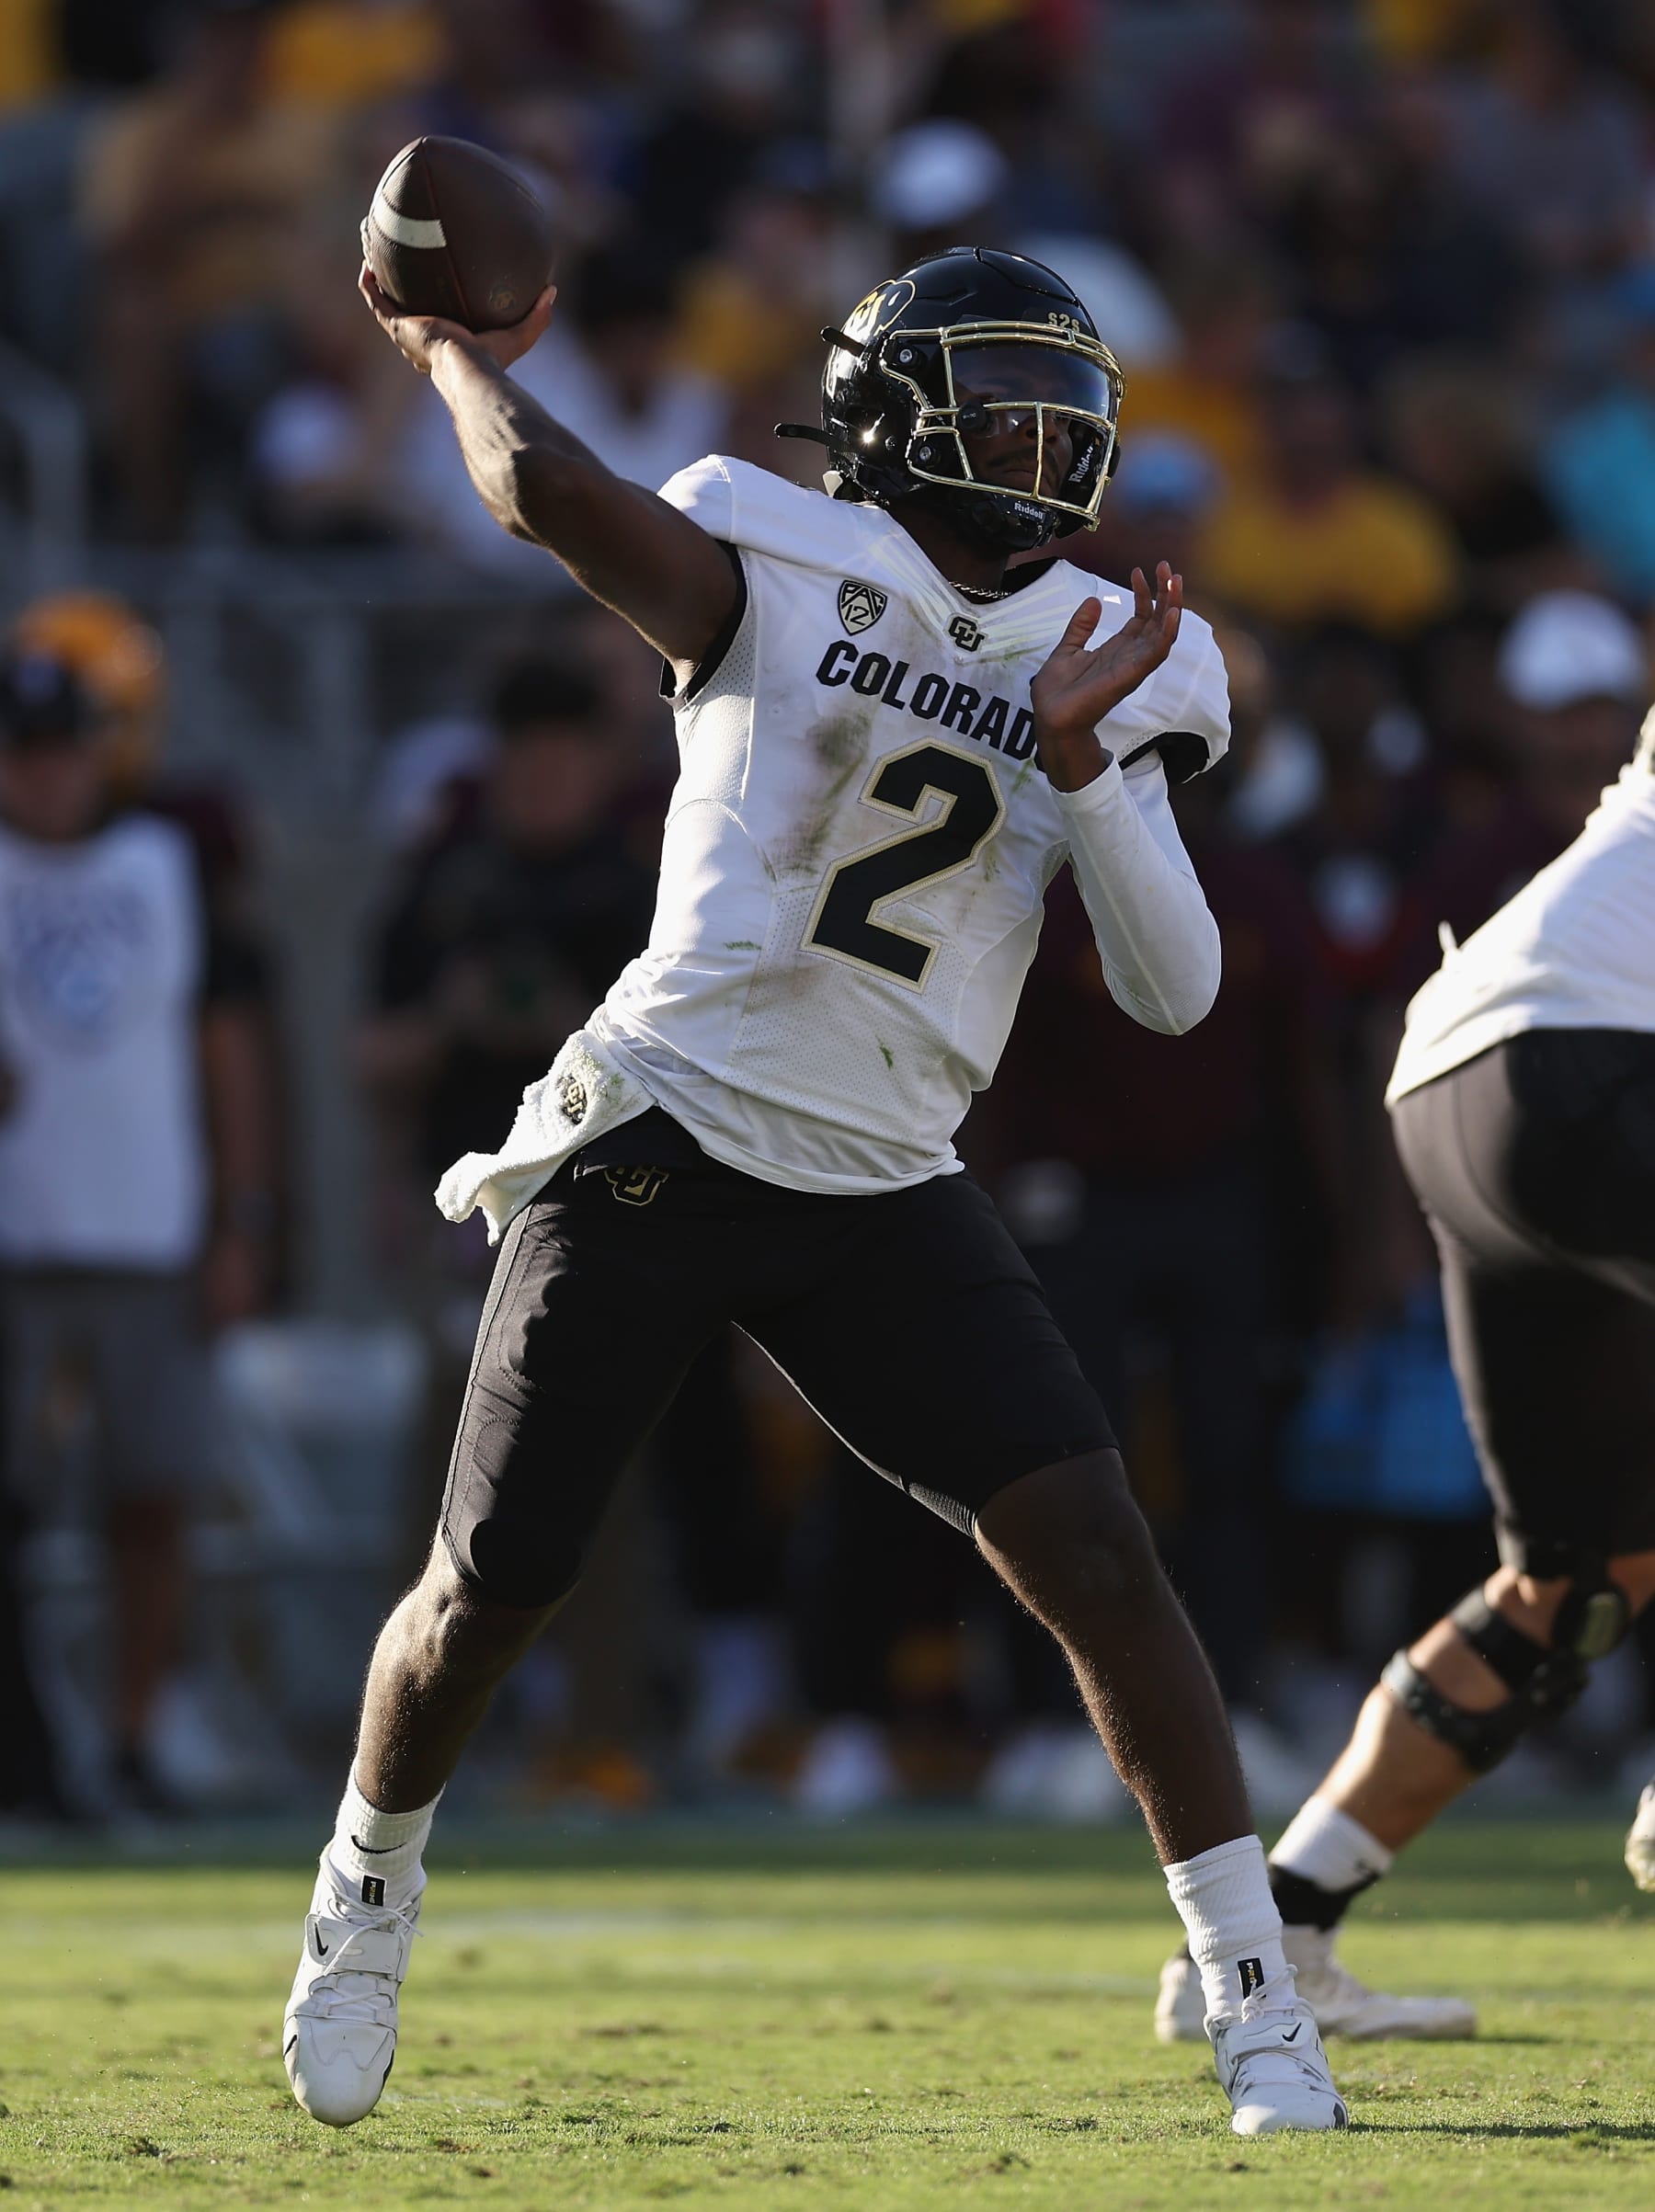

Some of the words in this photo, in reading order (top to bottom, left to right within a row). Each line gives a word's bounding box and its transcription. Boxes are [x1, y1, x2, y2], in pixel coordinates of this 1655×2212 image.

[841, 583, 885, 621] PAC
[844, 604, 869, 626] 12
[948, 616, 985, 652] CU
[816, 640, 1046, 773] COLORAD
[800, 736, 1007, 995] 2
